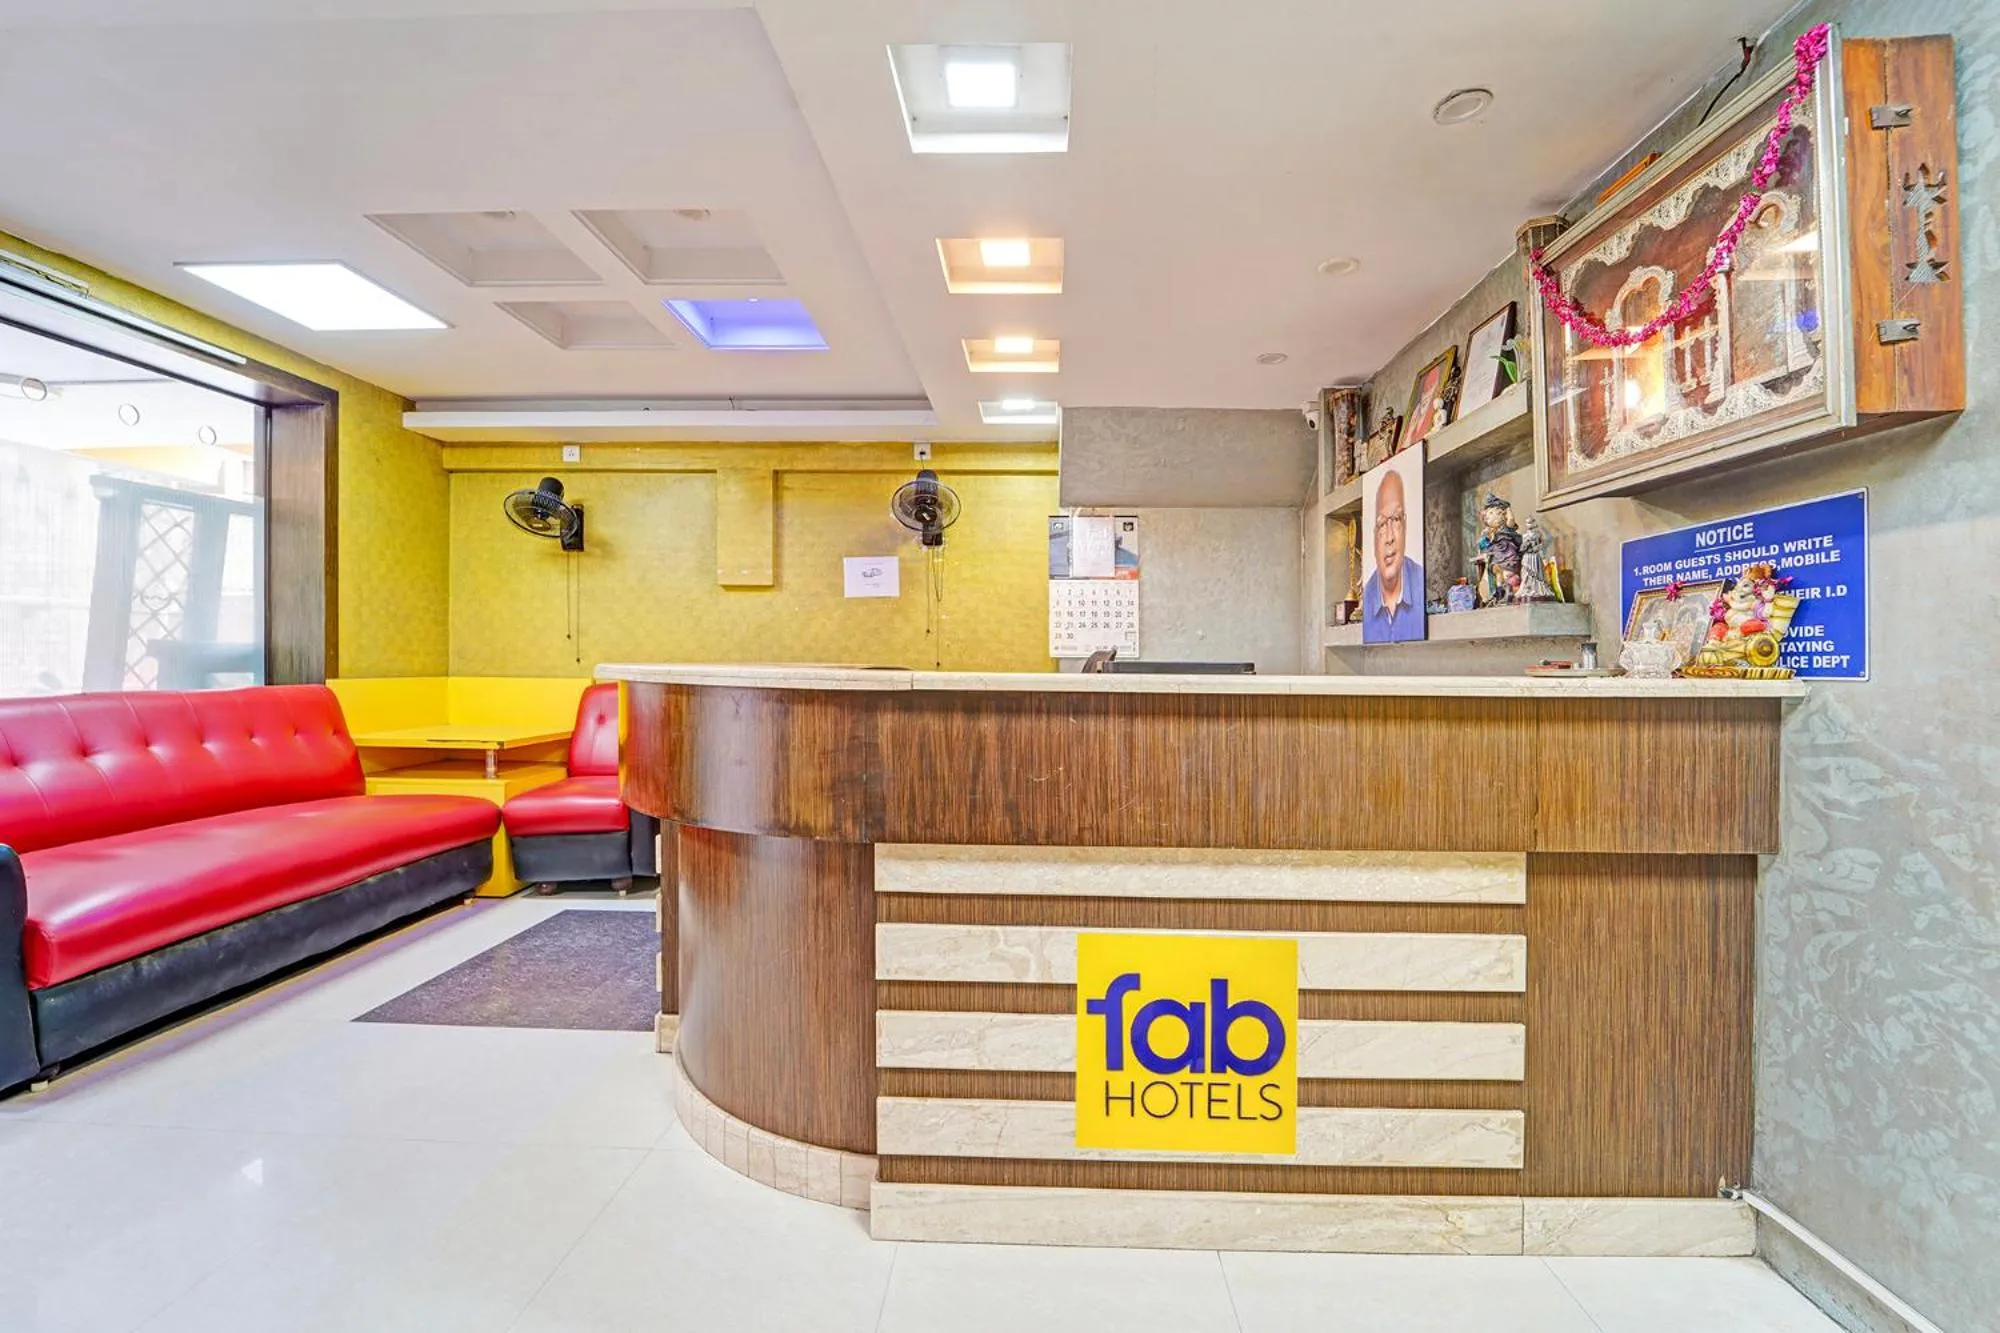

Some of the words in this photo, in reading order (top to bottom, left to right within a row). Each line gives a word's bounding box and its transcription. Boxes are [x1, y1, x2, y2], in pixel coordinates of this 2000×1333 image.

[1695, 522, 1754, 548] NOTICE
[1675, 553, 1721, 569] GUESTS
[1724, 544, 1779, 562] SHOULD
[1783, 534, 1834, 554] WRITE
[1642, 573, 1673, 587] THEIR
[1676, 568, 1713, 582] NAME,
[1779, 587, 1821, 599] HEIR
[1825, 584, 1848, 598] I.D
[1784, 624, 1825, 637] VIDE
[1777, 655, 1809, 669] LICE
[1812, 655, 1851, 669] DEPT
[1086, 972, 1286, 1077] fab
[1105, 1080, 1283, 1121] HOTELS
